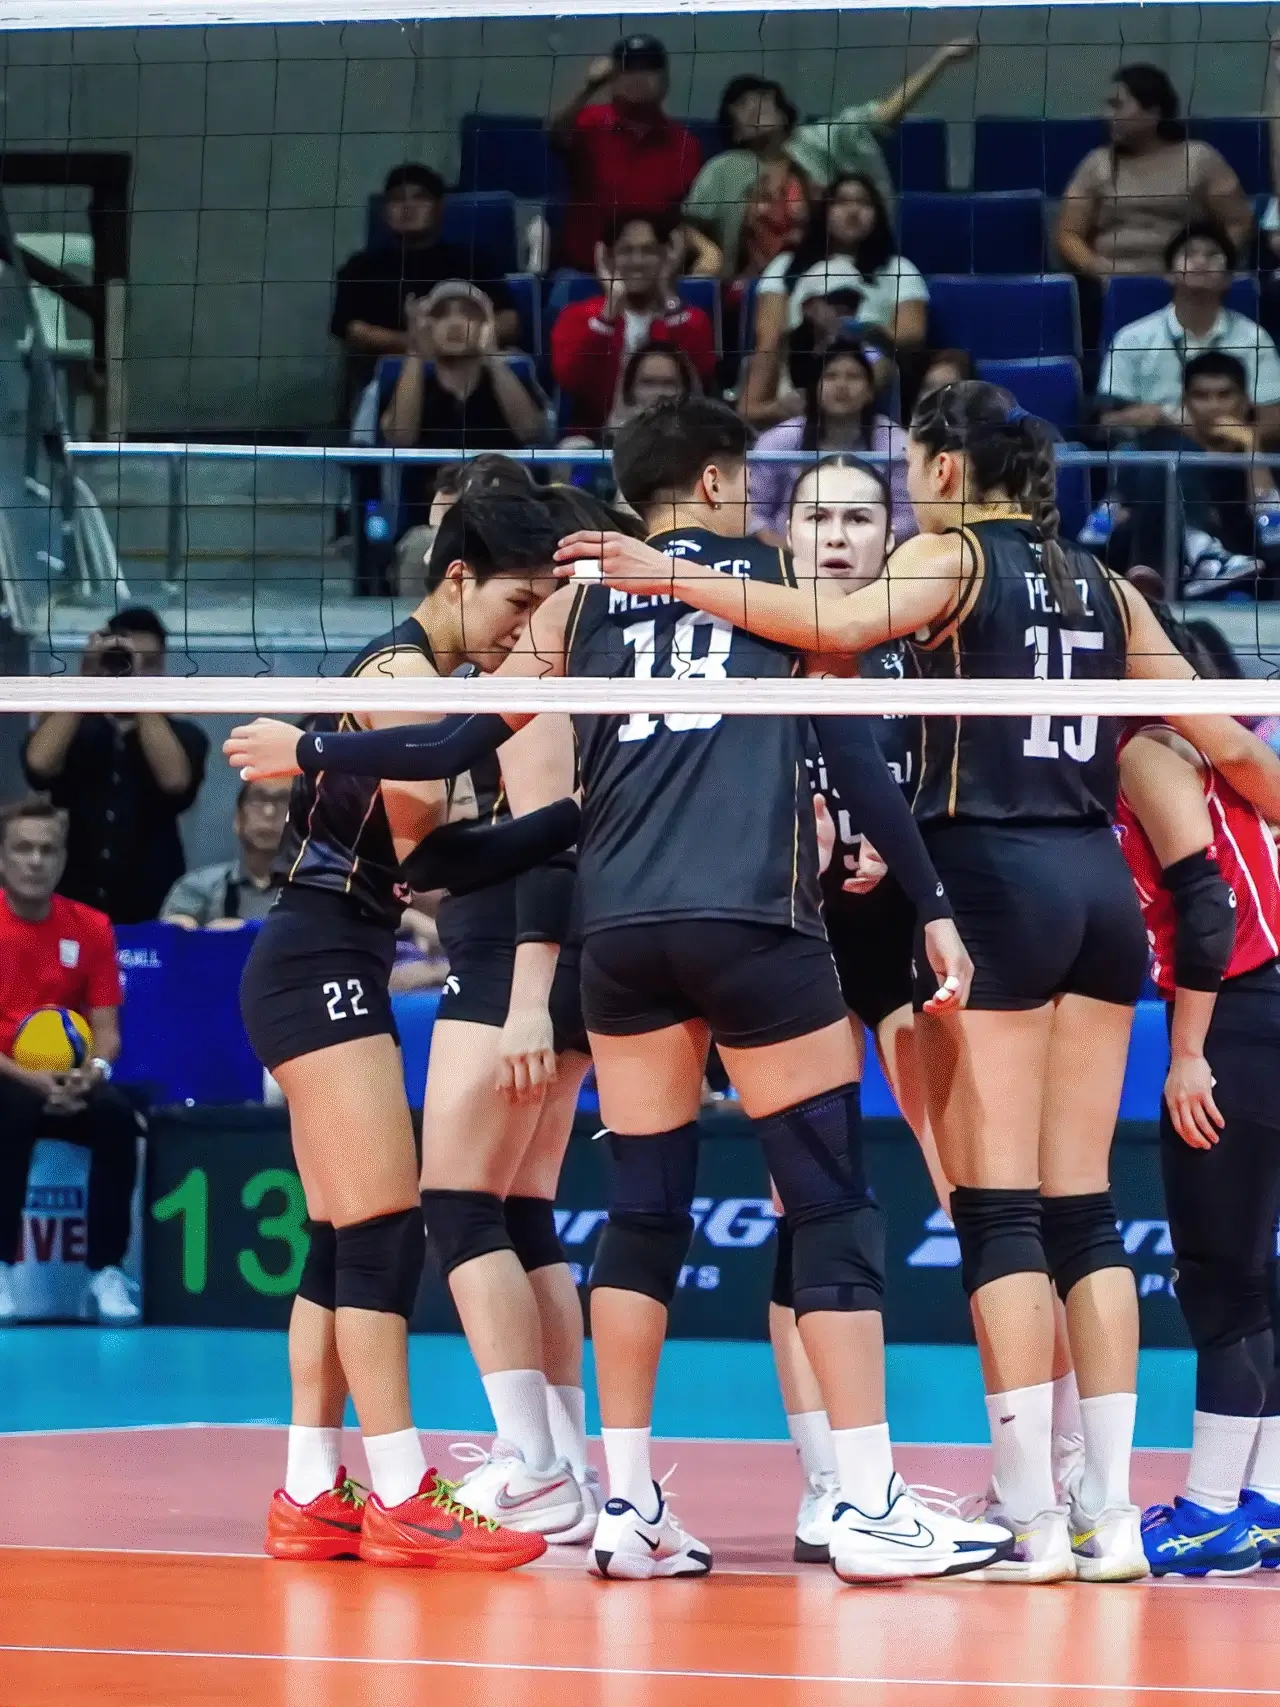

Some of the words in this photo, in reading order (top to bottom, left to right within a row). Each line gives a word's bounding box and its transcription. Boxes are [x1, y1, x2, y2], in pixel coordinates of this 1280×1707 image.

[1024, 571, 1095, 617] PEZ
[618, 611, 734, 742] 18
[1023, 625, 1105, 763] 15
[322, 978, 369, 1021] 22
[152, 1168, 311, 1297] 13
